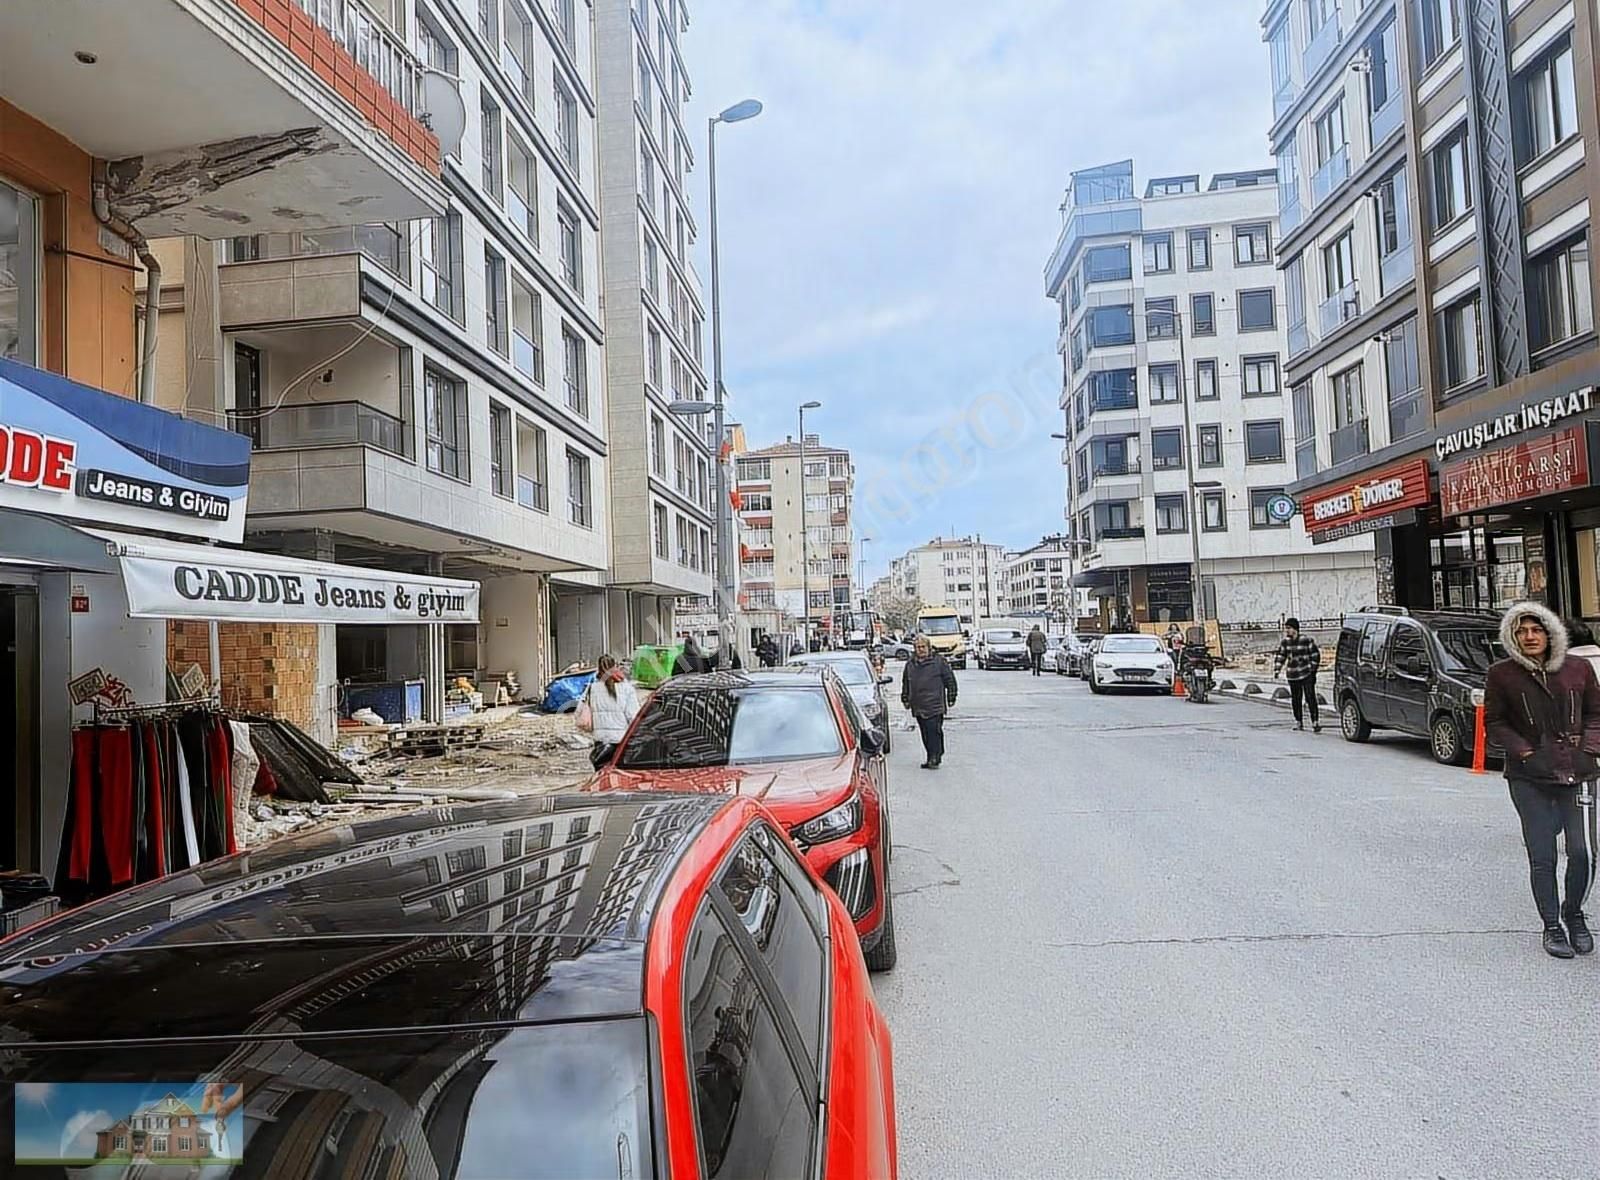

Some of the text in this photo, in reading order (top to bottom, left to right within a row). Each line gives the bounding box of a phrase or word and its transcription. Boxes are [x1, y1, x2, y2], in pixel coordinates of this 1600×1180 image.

[1435, 386, 1593, 461] ÇAVUŞLAR İNŞAAT
[0, 426, 76, 491] DE
[89, 473, 228, 518] Jeans & Giyim
[1361, 478, 1405, 507] DÖNER
[174, 566, 465, 617] CADDE Jeans & giyim
